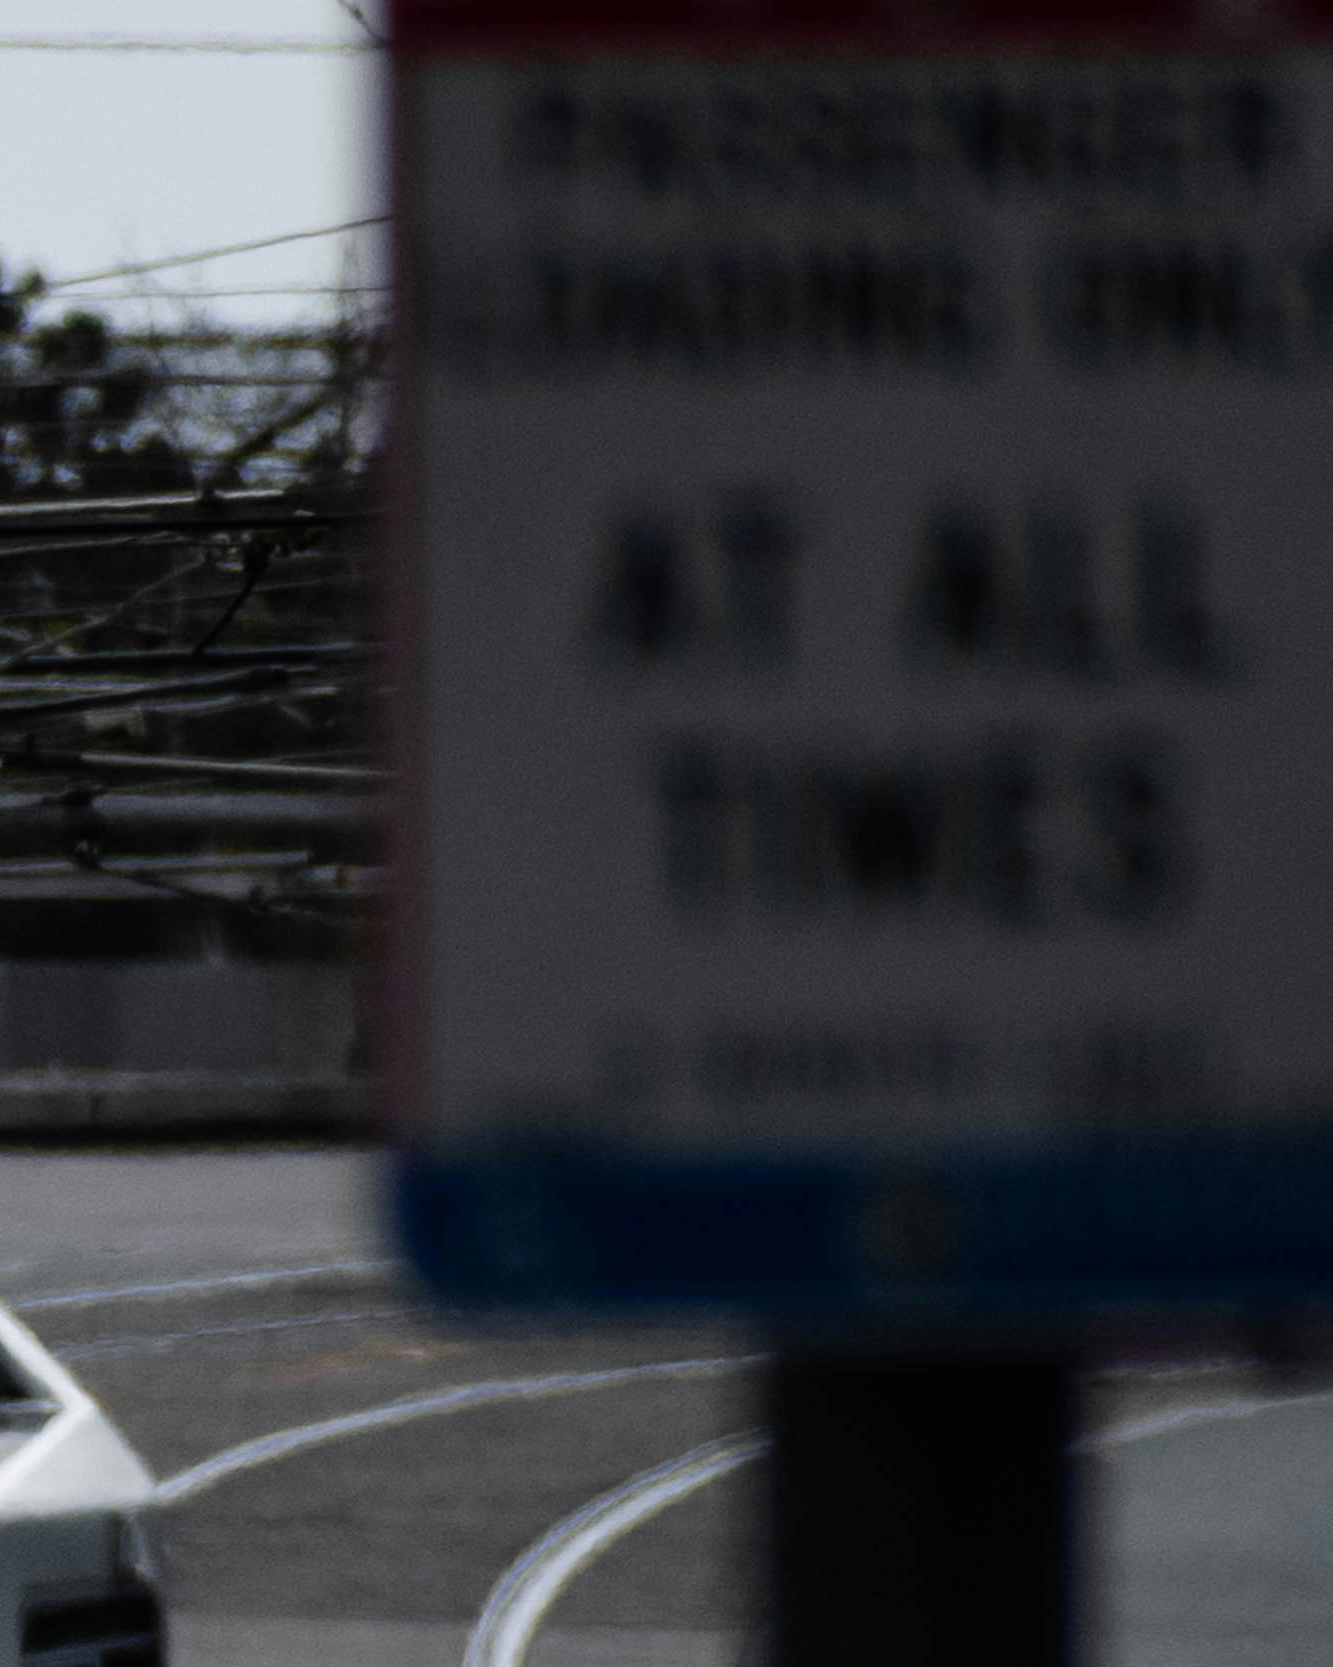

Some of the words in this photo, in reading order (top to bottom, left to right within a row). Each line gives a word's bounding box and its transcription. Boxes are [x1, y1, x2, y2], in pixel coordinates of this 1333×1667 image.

[588, 487, 798, 672] AT
[900, 487, 1245, 675] ALL
[655, 733, 1201, 926] TIMES
